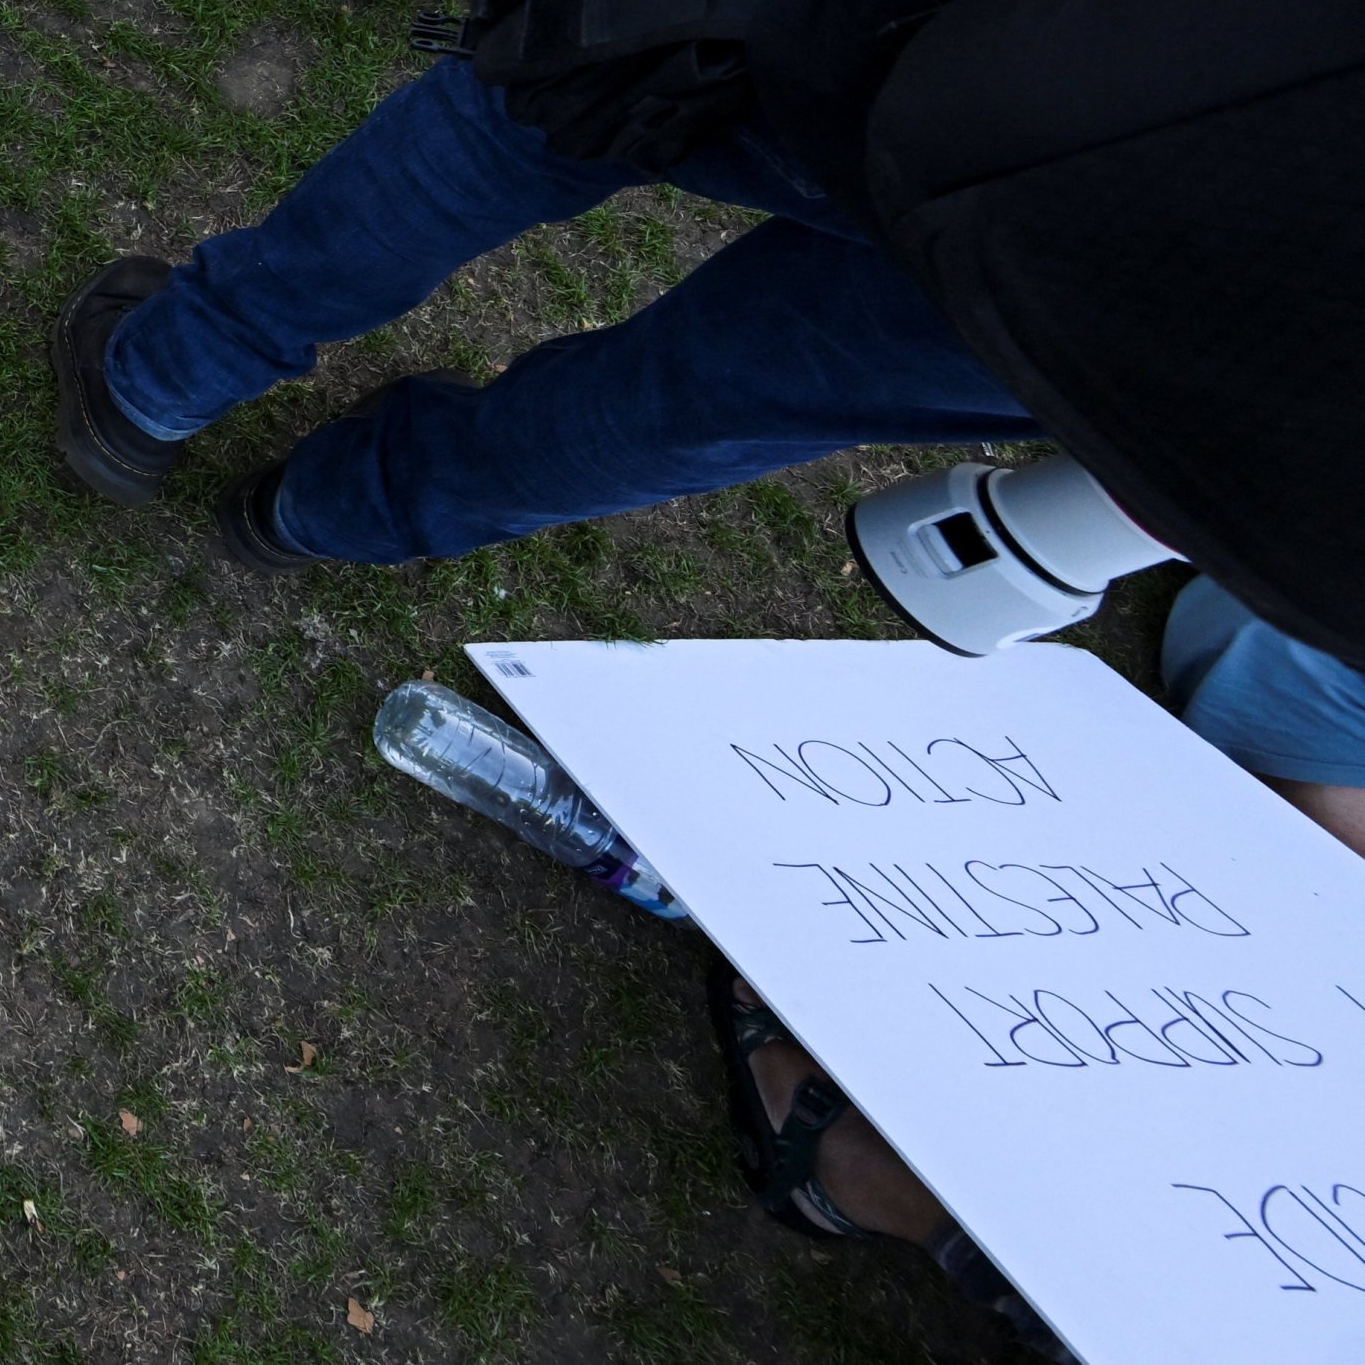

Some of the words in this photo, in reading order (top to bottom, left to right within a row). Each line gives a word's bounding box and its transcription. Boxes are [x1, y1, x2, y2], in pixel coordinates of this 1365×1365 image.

[730, 736, 1062, 806] ACTION
[773, 862, 1251, 944] PALESTINE
[928, 983, 1323, 1067] SUPPORT
